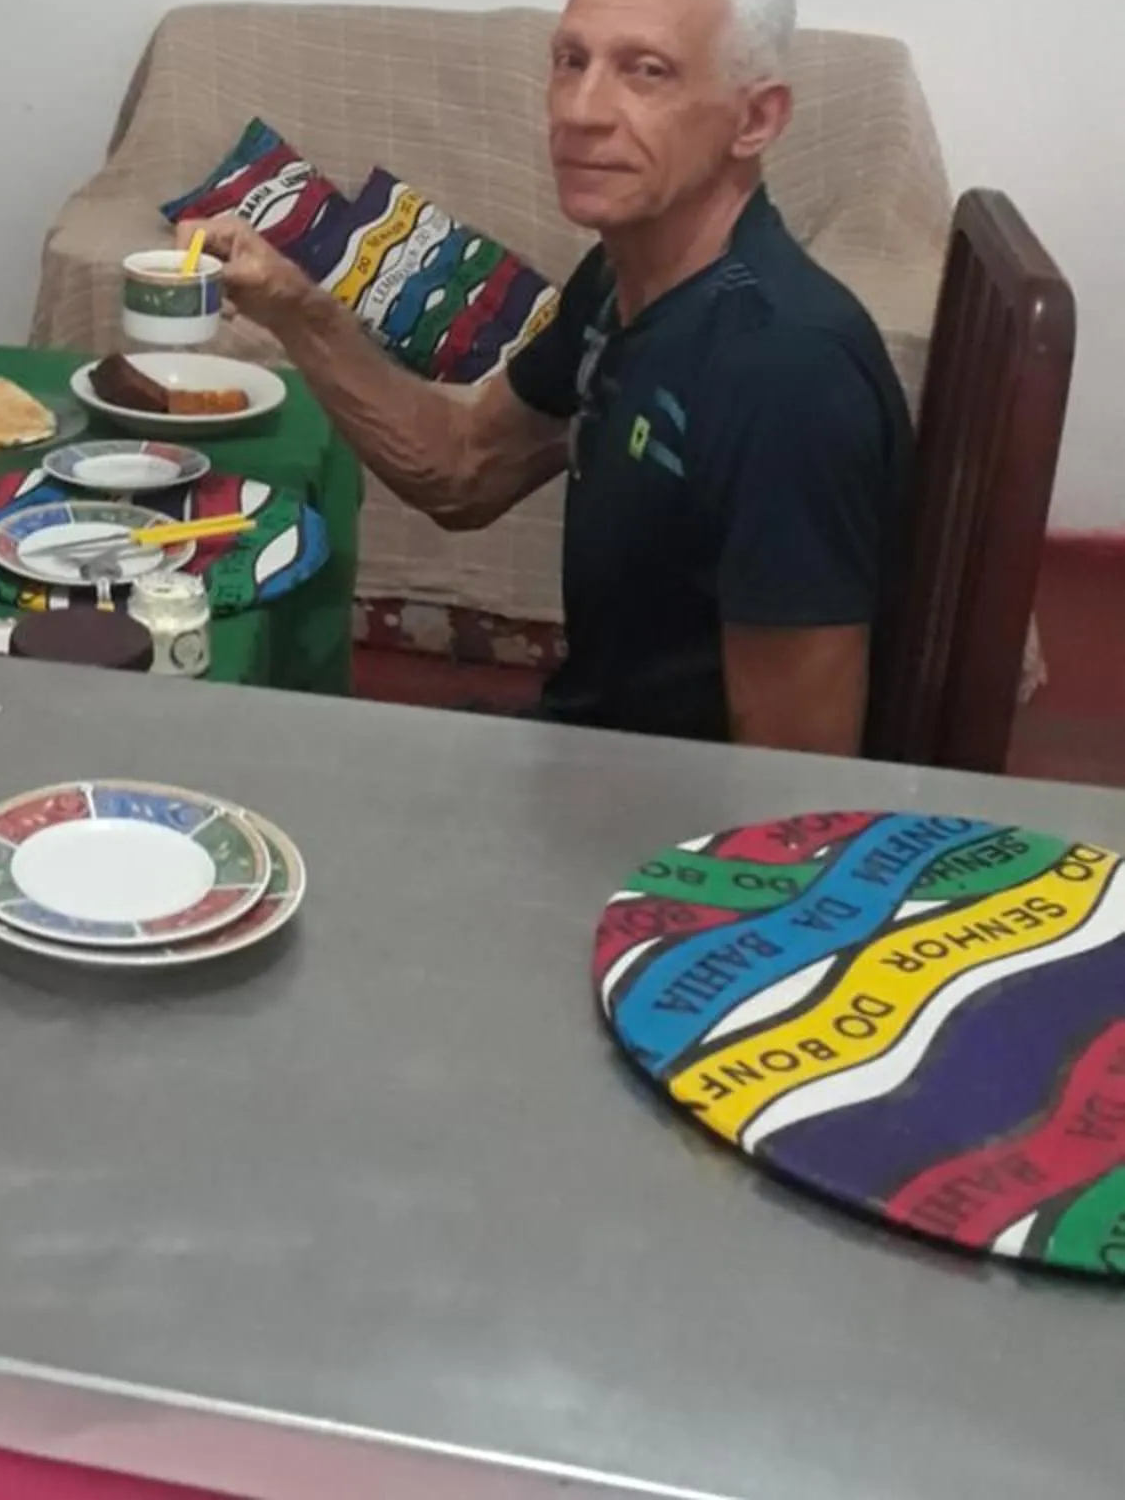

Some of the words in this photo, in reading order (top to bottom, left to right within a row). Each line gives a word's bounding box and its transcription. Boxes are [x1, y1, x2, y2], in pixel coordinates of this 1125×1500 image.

[1051, 843, 1107, 882] DO
[790, 896, 862, 933] DA
[880, 897, 1068, 974] SENHOR
[652, 930, 784, 1016] BAHIA
[832, 993, 896, 1041] DO
